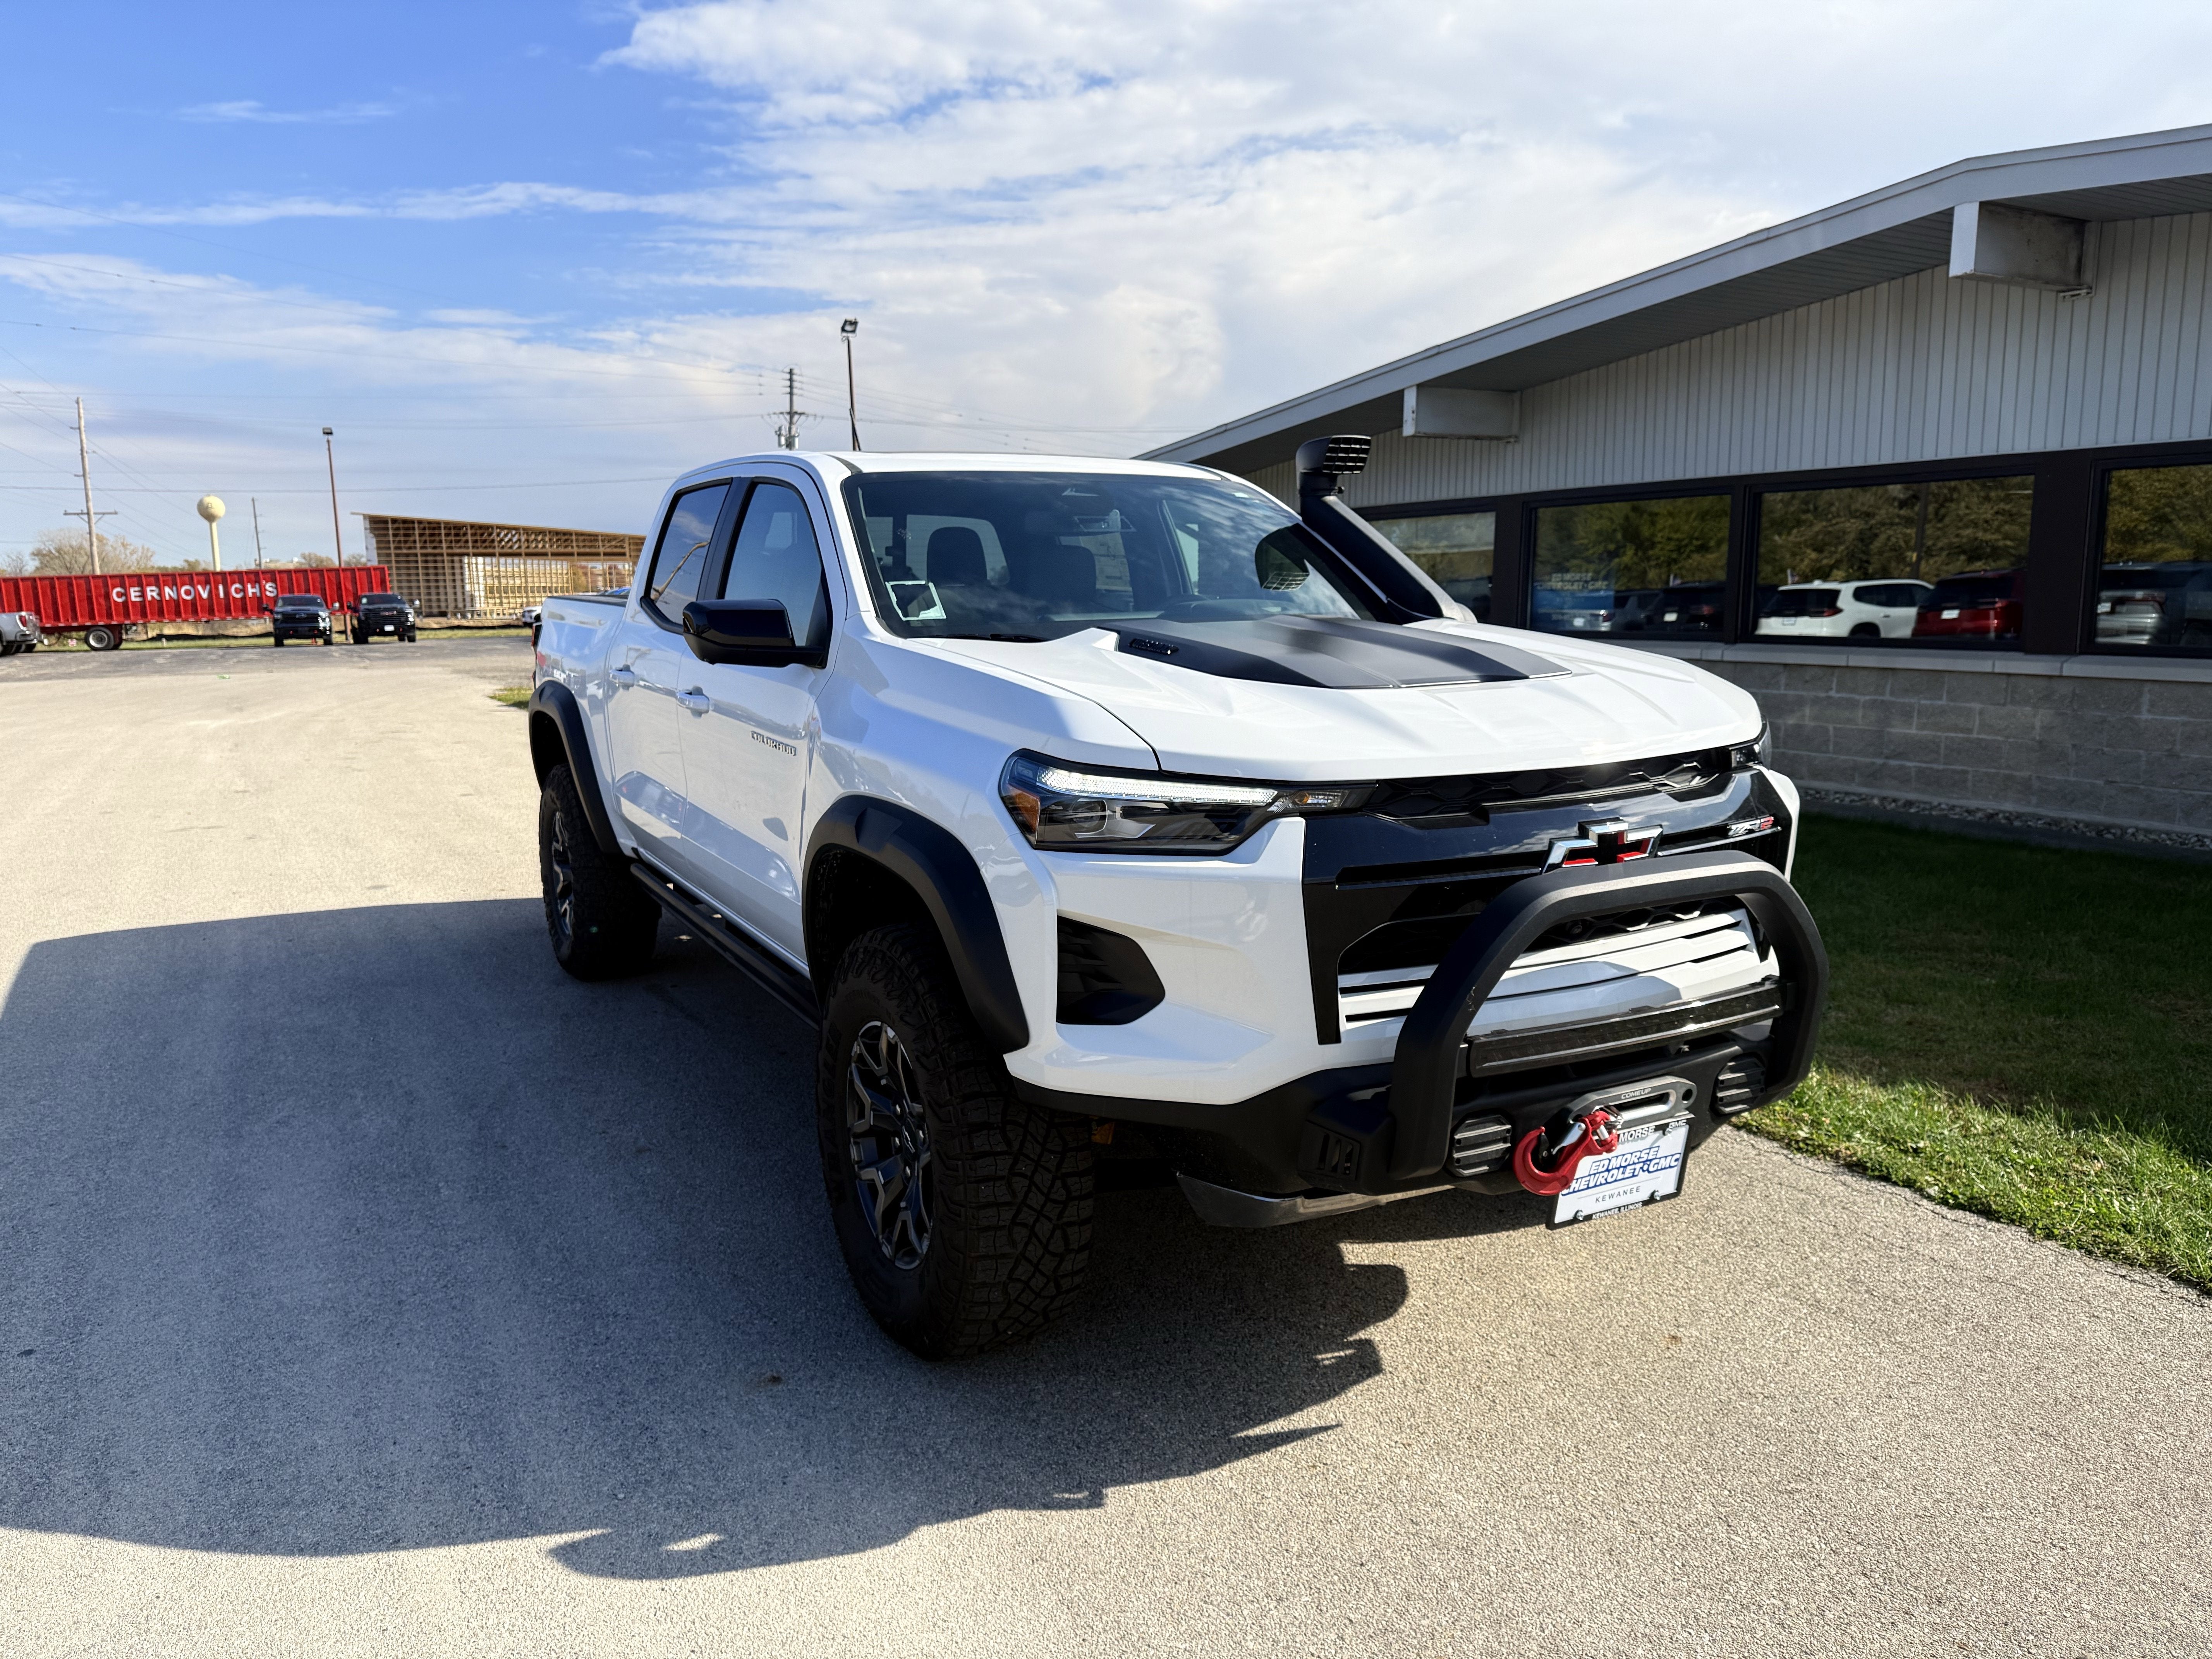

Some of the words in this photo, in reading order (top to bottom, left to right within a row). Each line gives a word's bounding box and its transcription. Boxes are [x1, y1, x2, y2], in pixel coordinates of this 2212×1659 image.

[112, 580, 277, 602] CERNOVICH'S
[1621, 1088, 1651, 1099] COMEUP
[1618, 1126, 1656, 1142] MORSE
[1669, 1120, 1687, 1128] GMC
[1589, 1159, 1609, 1175] ED
[1607, 1146, 1660, 1170] MORSE
[1595, 1186, 1641, 1203] KEWANEE
[1620, 1202, 1643, 1212] ILLINOIS
